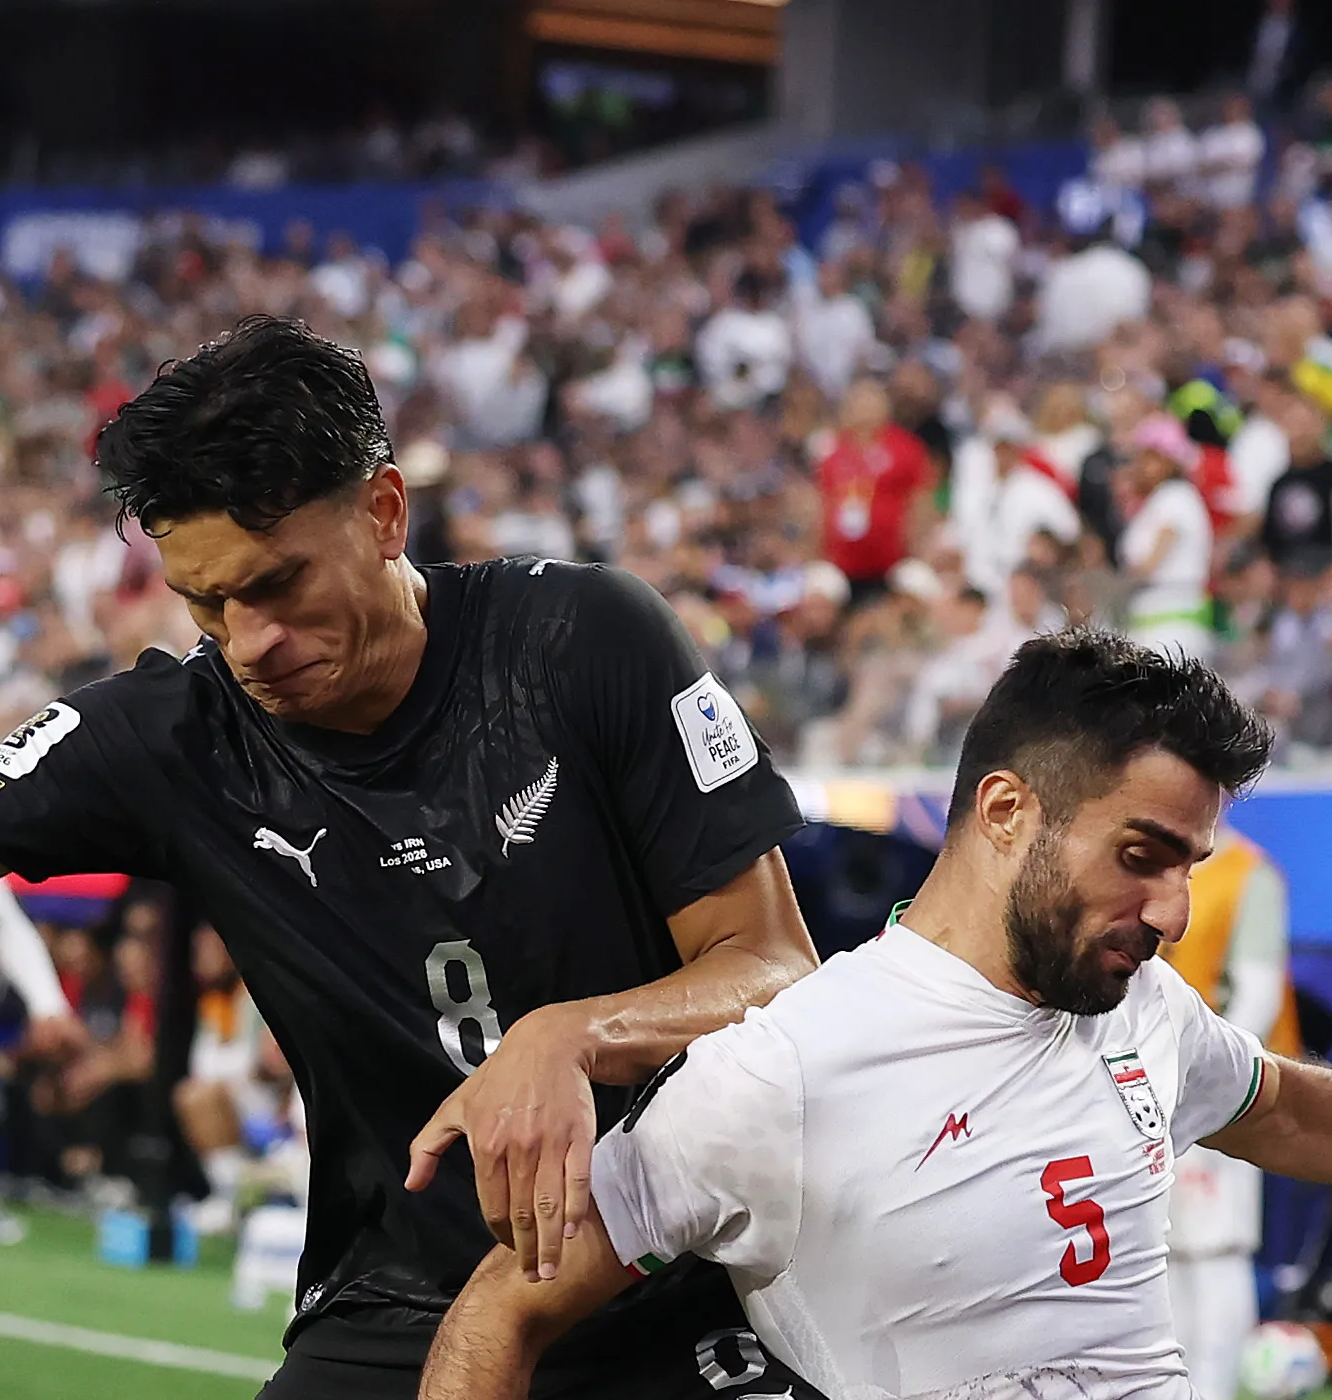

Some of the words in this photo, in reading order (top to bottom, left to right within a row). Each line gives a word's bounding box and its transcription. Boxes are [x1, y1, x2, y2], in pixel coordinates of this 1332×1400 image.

[708, 733, 741, 762] PEACE
[722, 755, 740, 769] FIFA
[403, 838, 425, 849] IRN
[380, 857, 401, 867] Los
[425, 857, 452, 871] USA
[425, 939, 503, 1077] 8
[1040, 1155, 1111, 1287] 5
